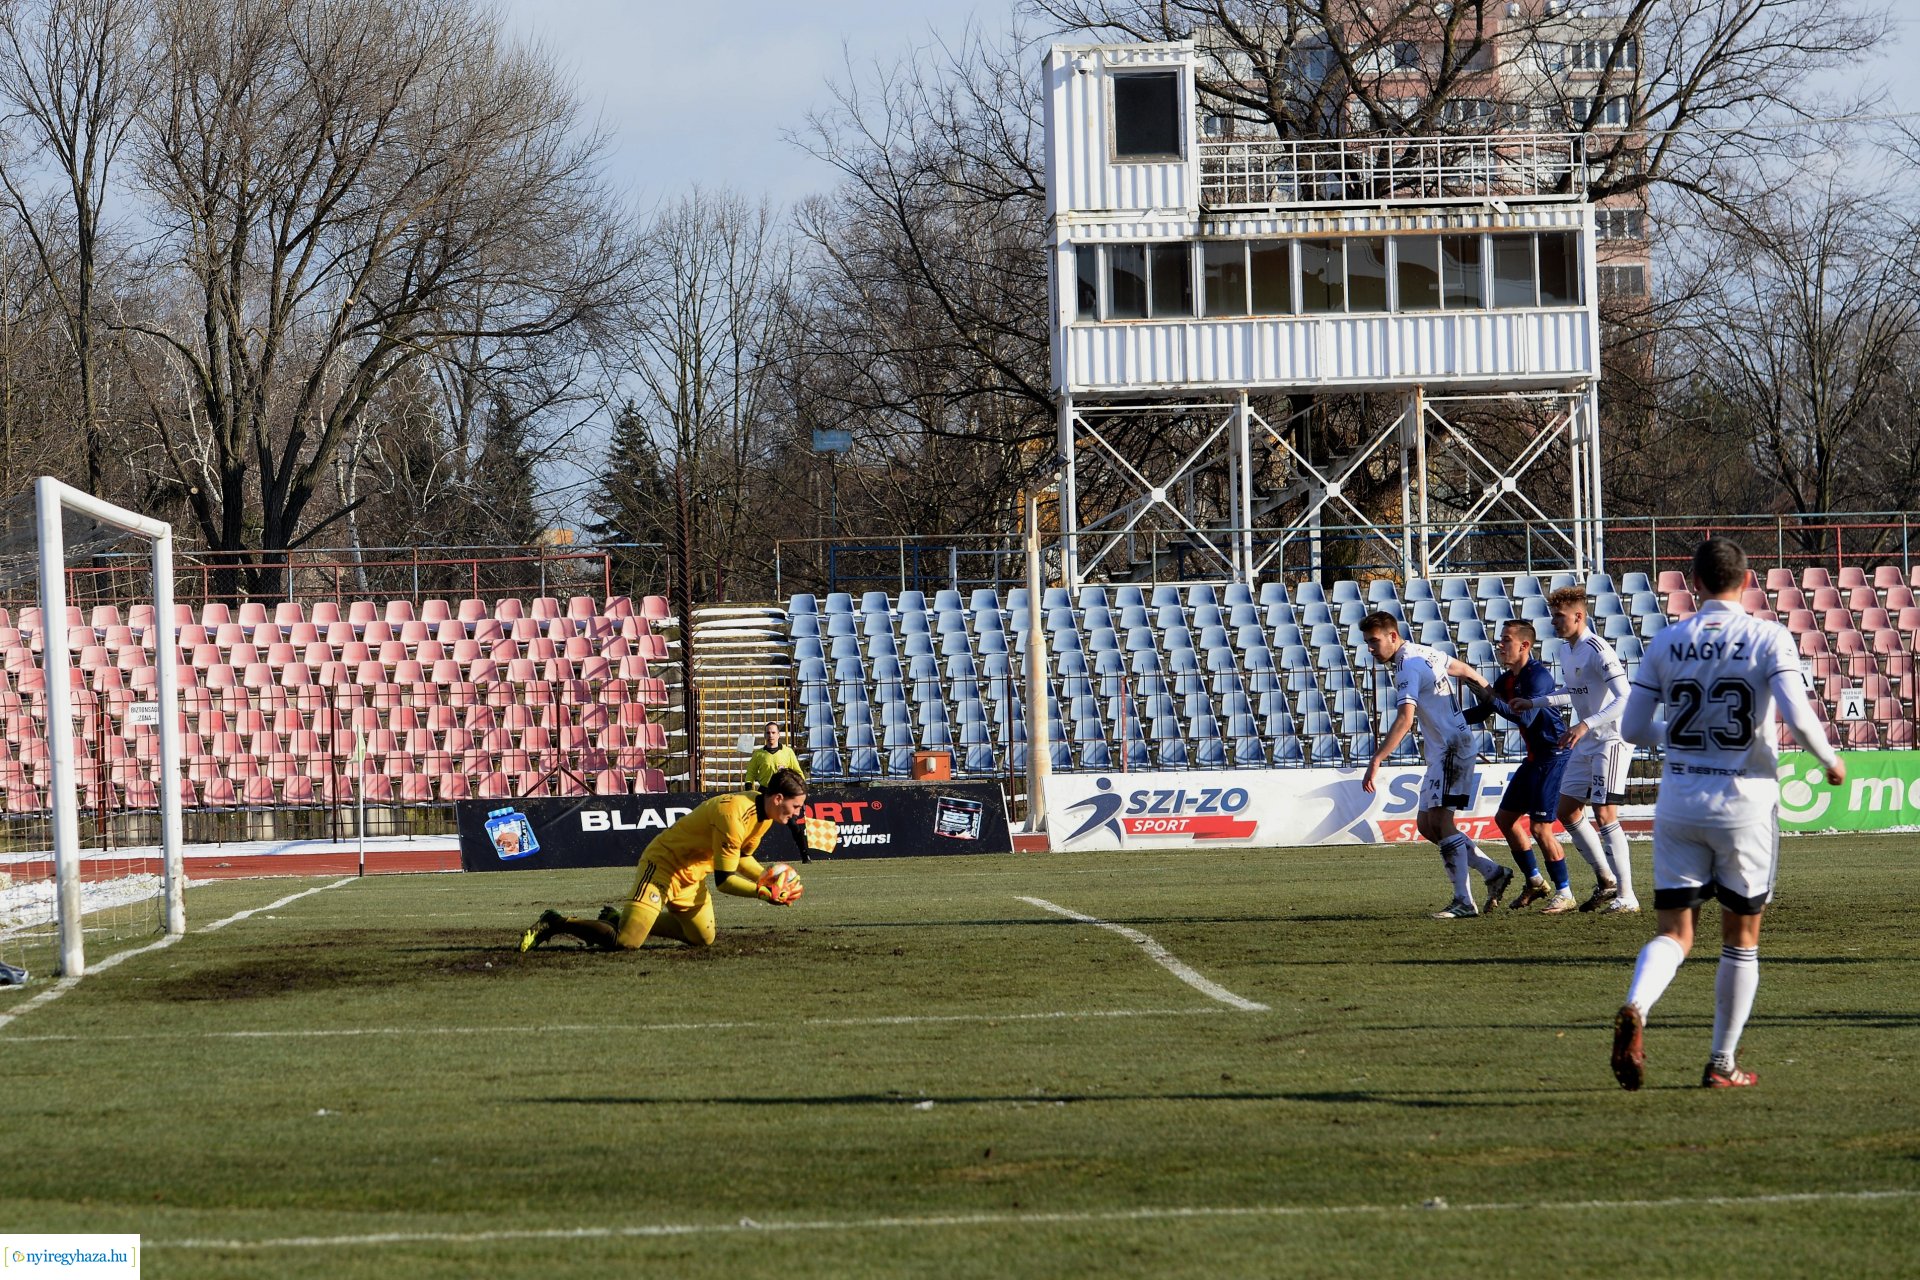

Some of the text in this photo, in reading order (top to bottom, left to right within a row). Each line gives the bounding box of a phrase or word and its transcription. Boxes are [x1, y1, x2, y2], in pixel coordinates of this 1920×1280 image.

[1670, 642, 1750, 661] NAGY Z.
[1666, 677, 1757, 752] 23
[1846, 701, 1860, 717] A
[1429, 779, 1440, 790] 74
[1592, 775, 1605, 787] 55
[1125, 787, 1250, 815] SZI-ZO
[1132, 818, 1191, 832] SPORT
[843, 834, 891, 848] yours!
